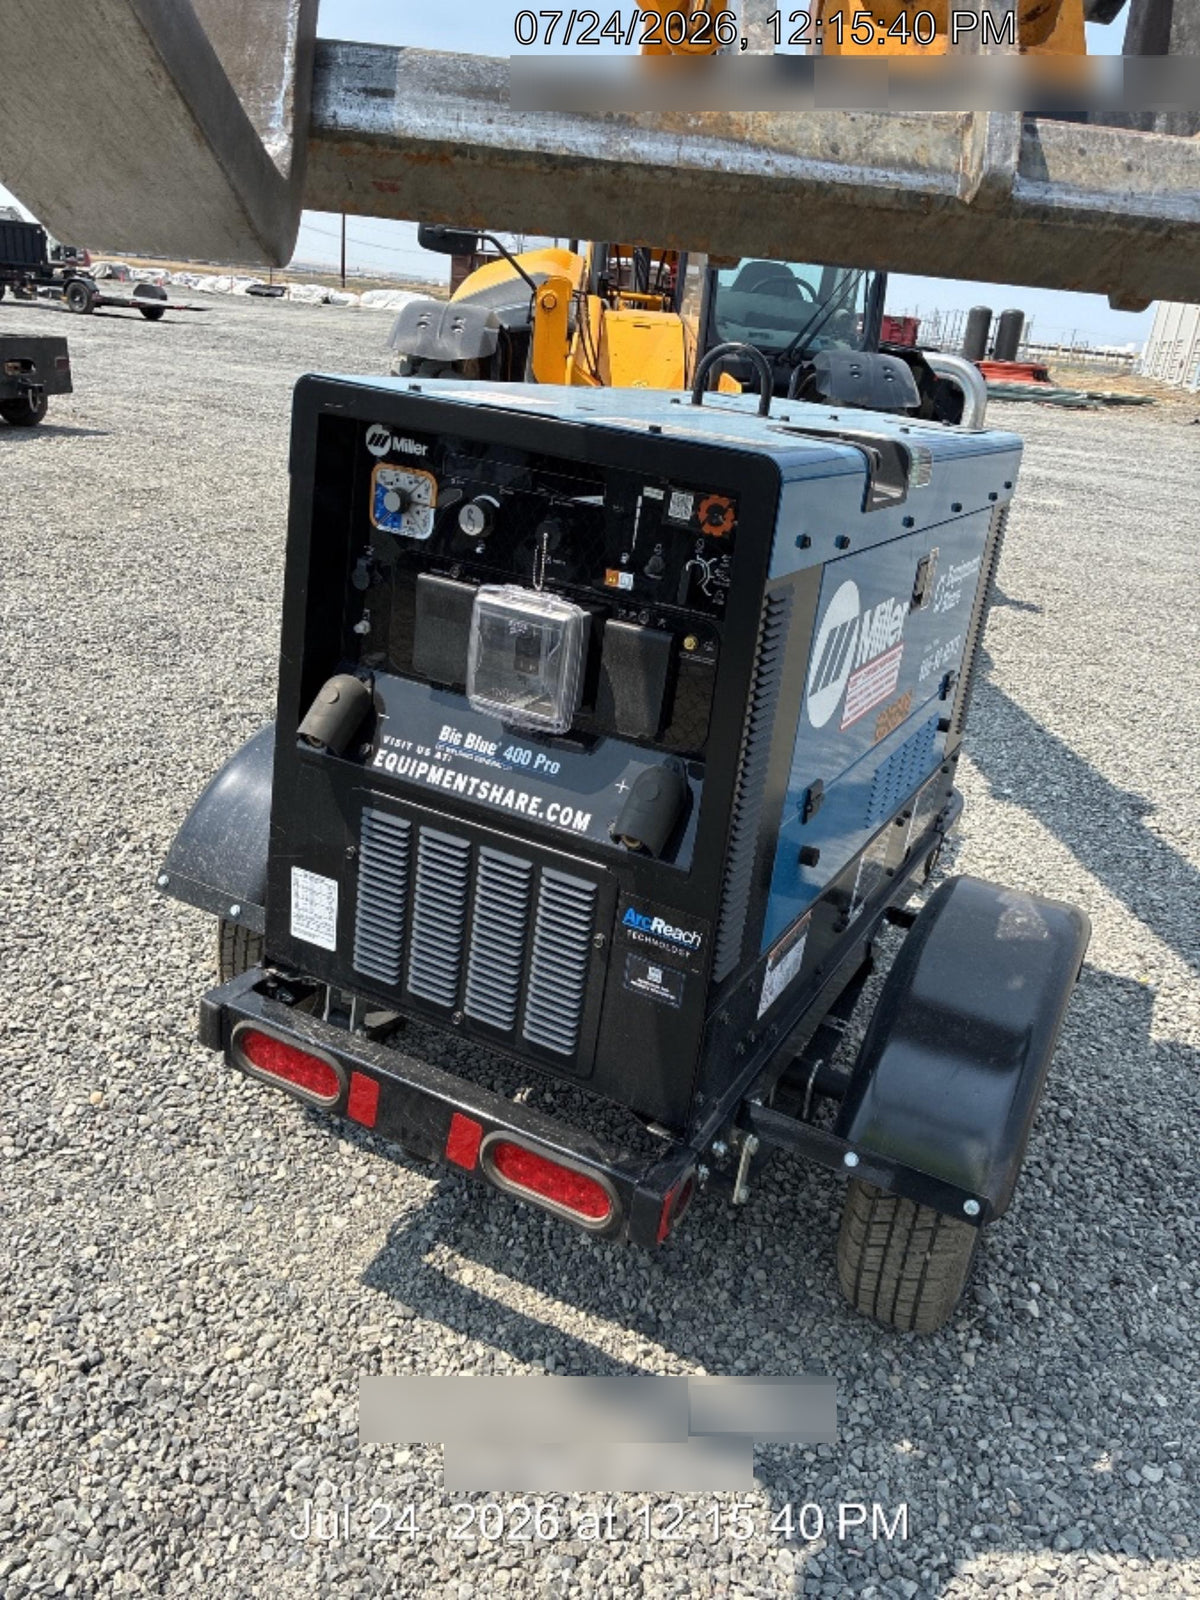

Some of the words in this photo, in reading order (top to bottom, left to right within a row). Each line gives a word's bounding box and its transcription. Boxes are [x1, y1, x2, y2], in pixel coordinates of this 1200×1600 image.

[392, 436, 428, 456] Miller
[855, 597, 909, 669] Miller
[383, 735, 412, 752] VISIT
[416, 745, 431, 757] US
[438, 725, 463, 746] Big
[503, 745, 532, 766] 400
[533, 755, 561, 775] Pro
[373, 748, 592, 832] EQUIPMENTSHARE.COM
[623, 907, 703, 947] ArcReach
[626, 929, 691, 958] TECHNOLOGY
